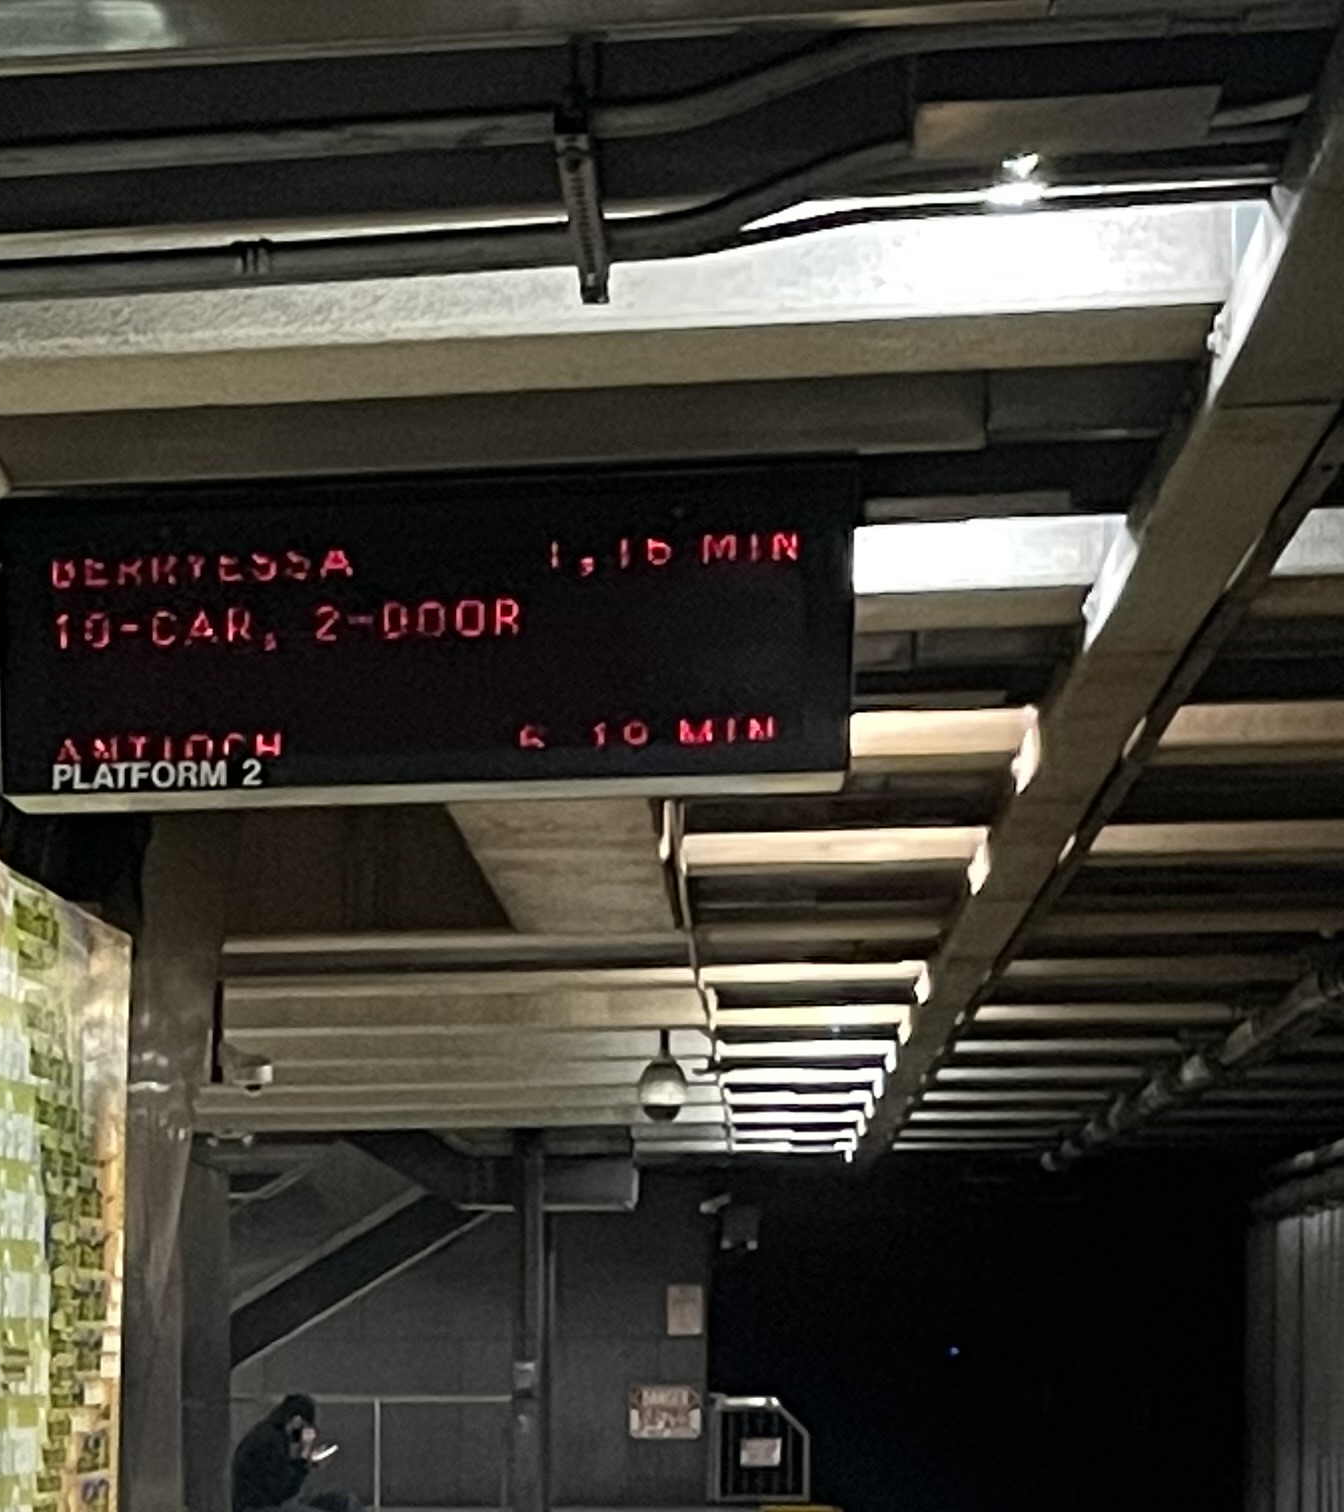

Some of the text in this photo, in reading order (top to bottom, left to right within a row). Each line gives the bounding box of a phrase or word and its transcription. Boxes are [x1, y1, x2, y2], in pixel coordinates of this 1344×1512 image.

[703, 532, 799, 566] MIN
[57, 599, 519, 650] 10-CAR, 2-DOOR
[52, 759, 262, 790] PLATFORM 2
